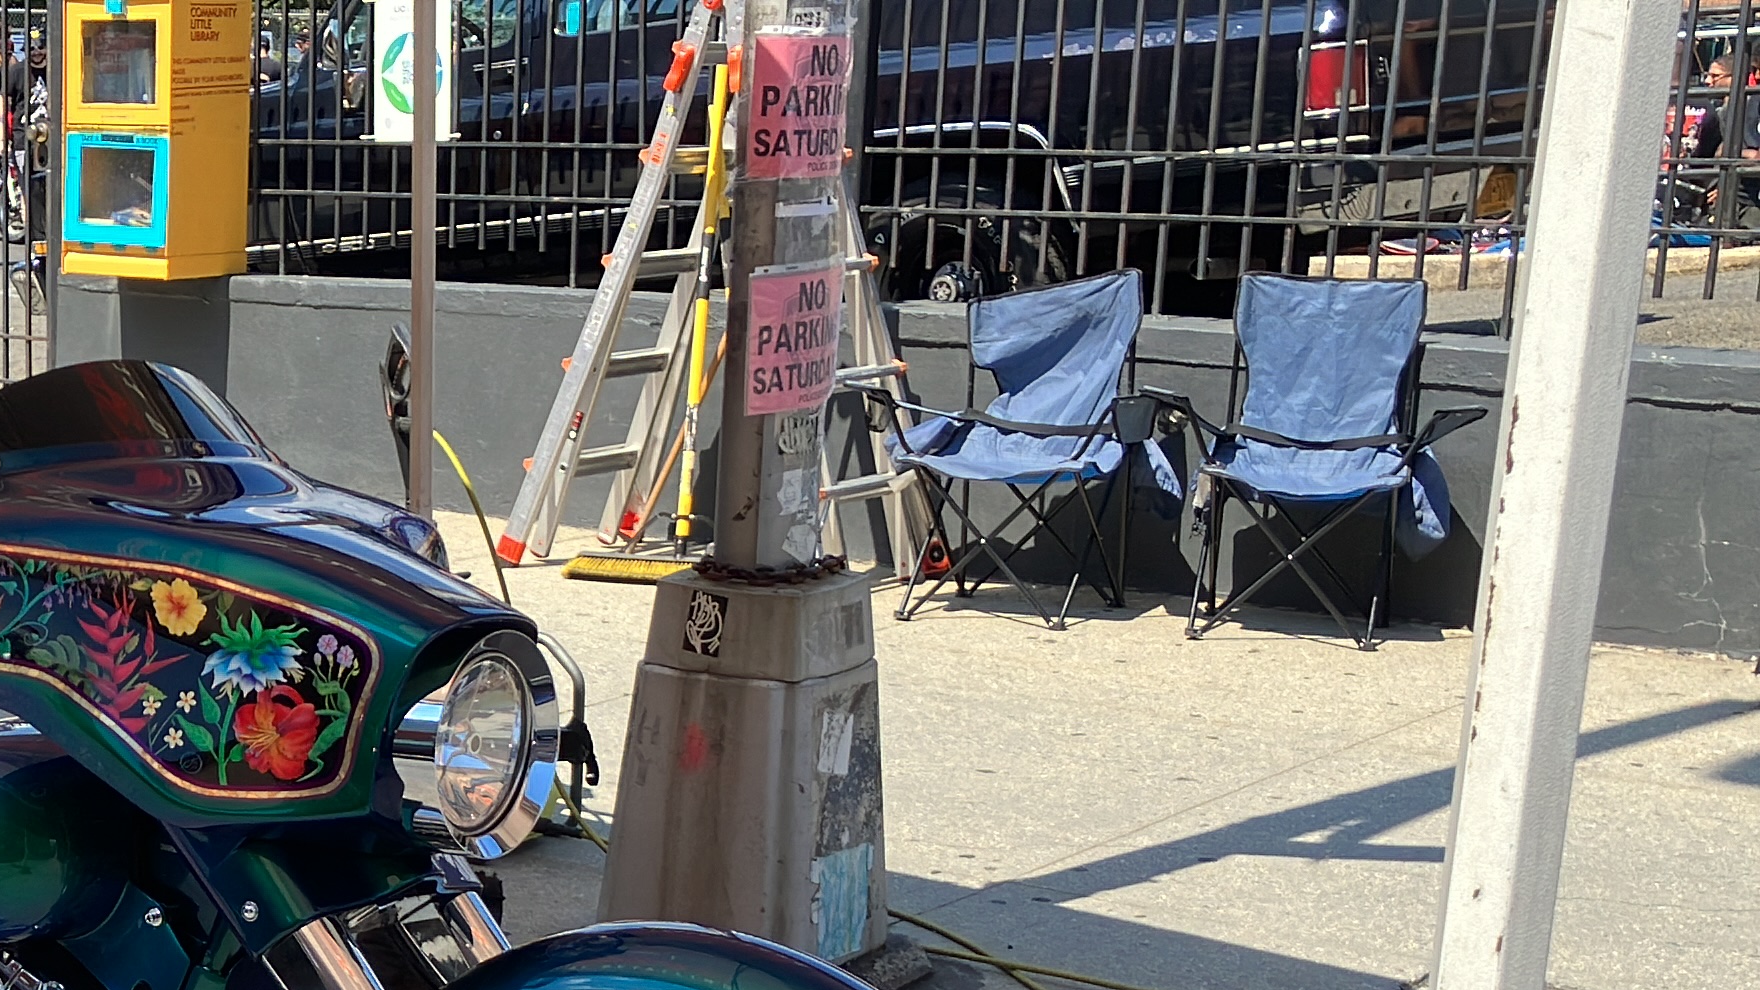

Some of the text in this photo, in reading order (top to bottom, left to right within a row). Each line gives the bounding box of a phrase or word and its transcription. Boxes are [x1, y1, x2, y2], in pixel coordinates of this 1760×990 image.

[190, 7, 237, 18] COMMUNITY
[190, 19, 212, 29] LITTLE
[190, 31, 220, 41] LIBRARY
[811, 44, 838, 77] NO
[799, 278, 826, 312] NO
